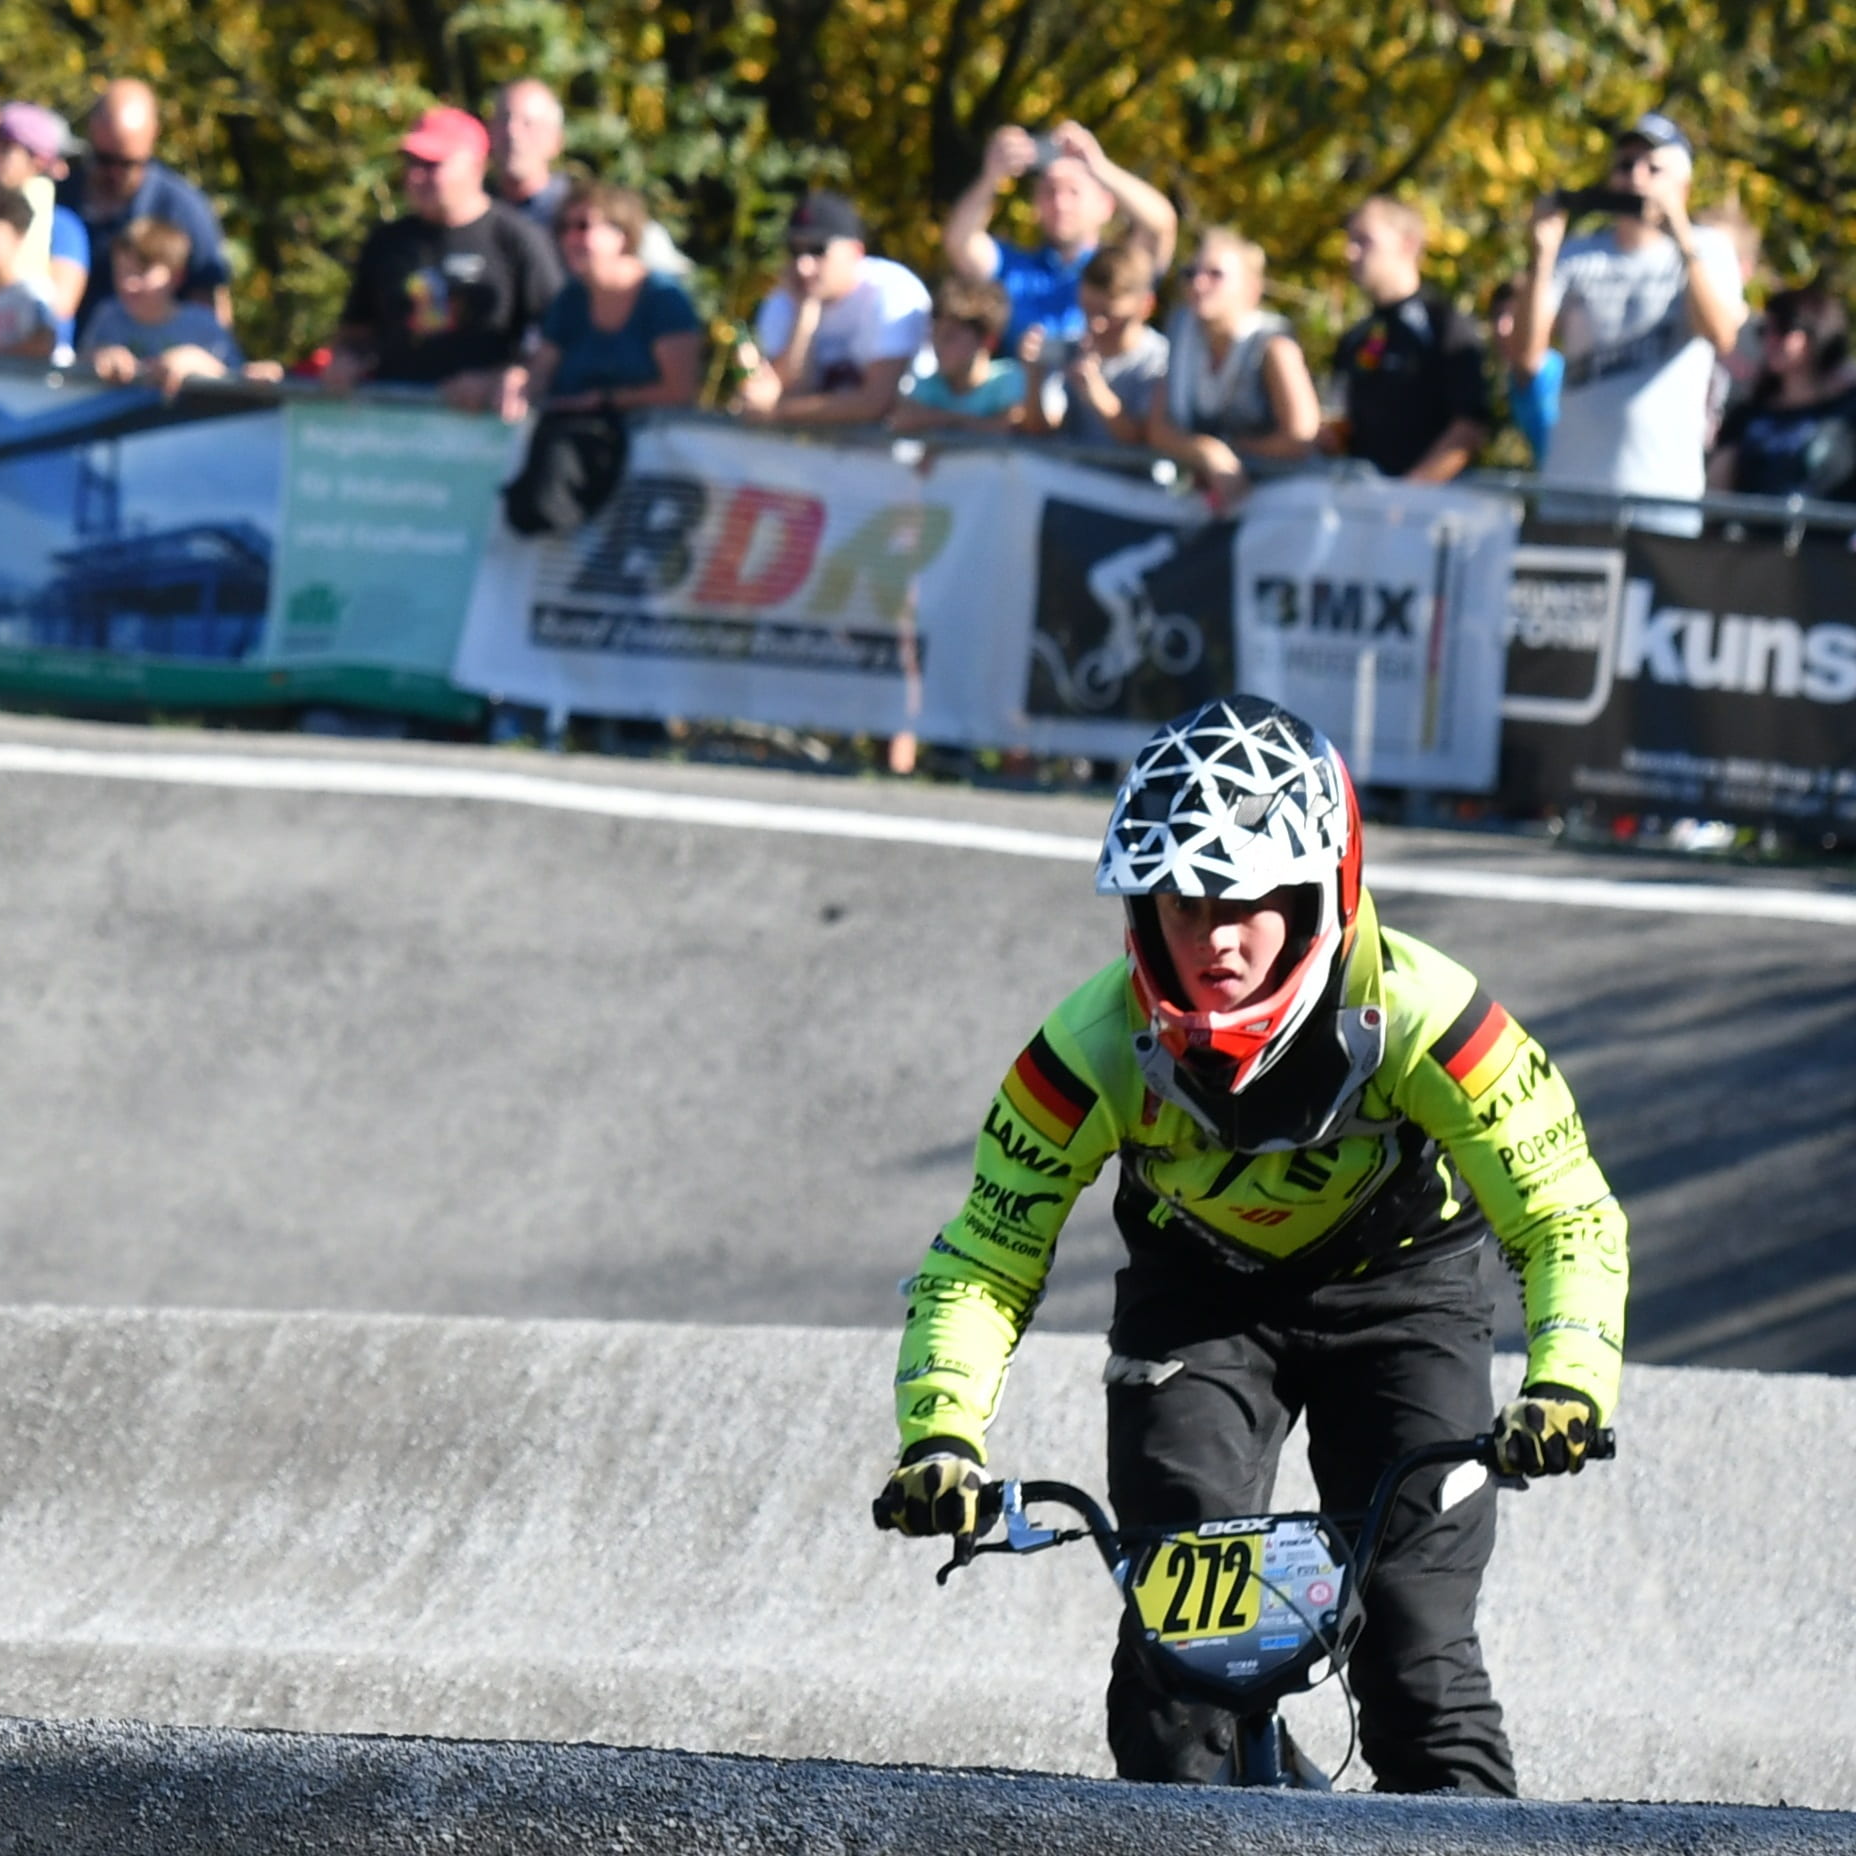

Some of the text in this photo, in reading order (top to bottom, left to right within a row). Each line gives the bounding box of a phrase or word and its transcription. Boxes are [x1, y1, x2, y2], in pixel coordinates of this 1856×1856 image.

[570, 474, 954, 622] BDR
[1254, 575, 1419, 637] BMX
[1197, 1516, 1275, 1537] BOX
[1161, 1540, 1252, 1634] 272
